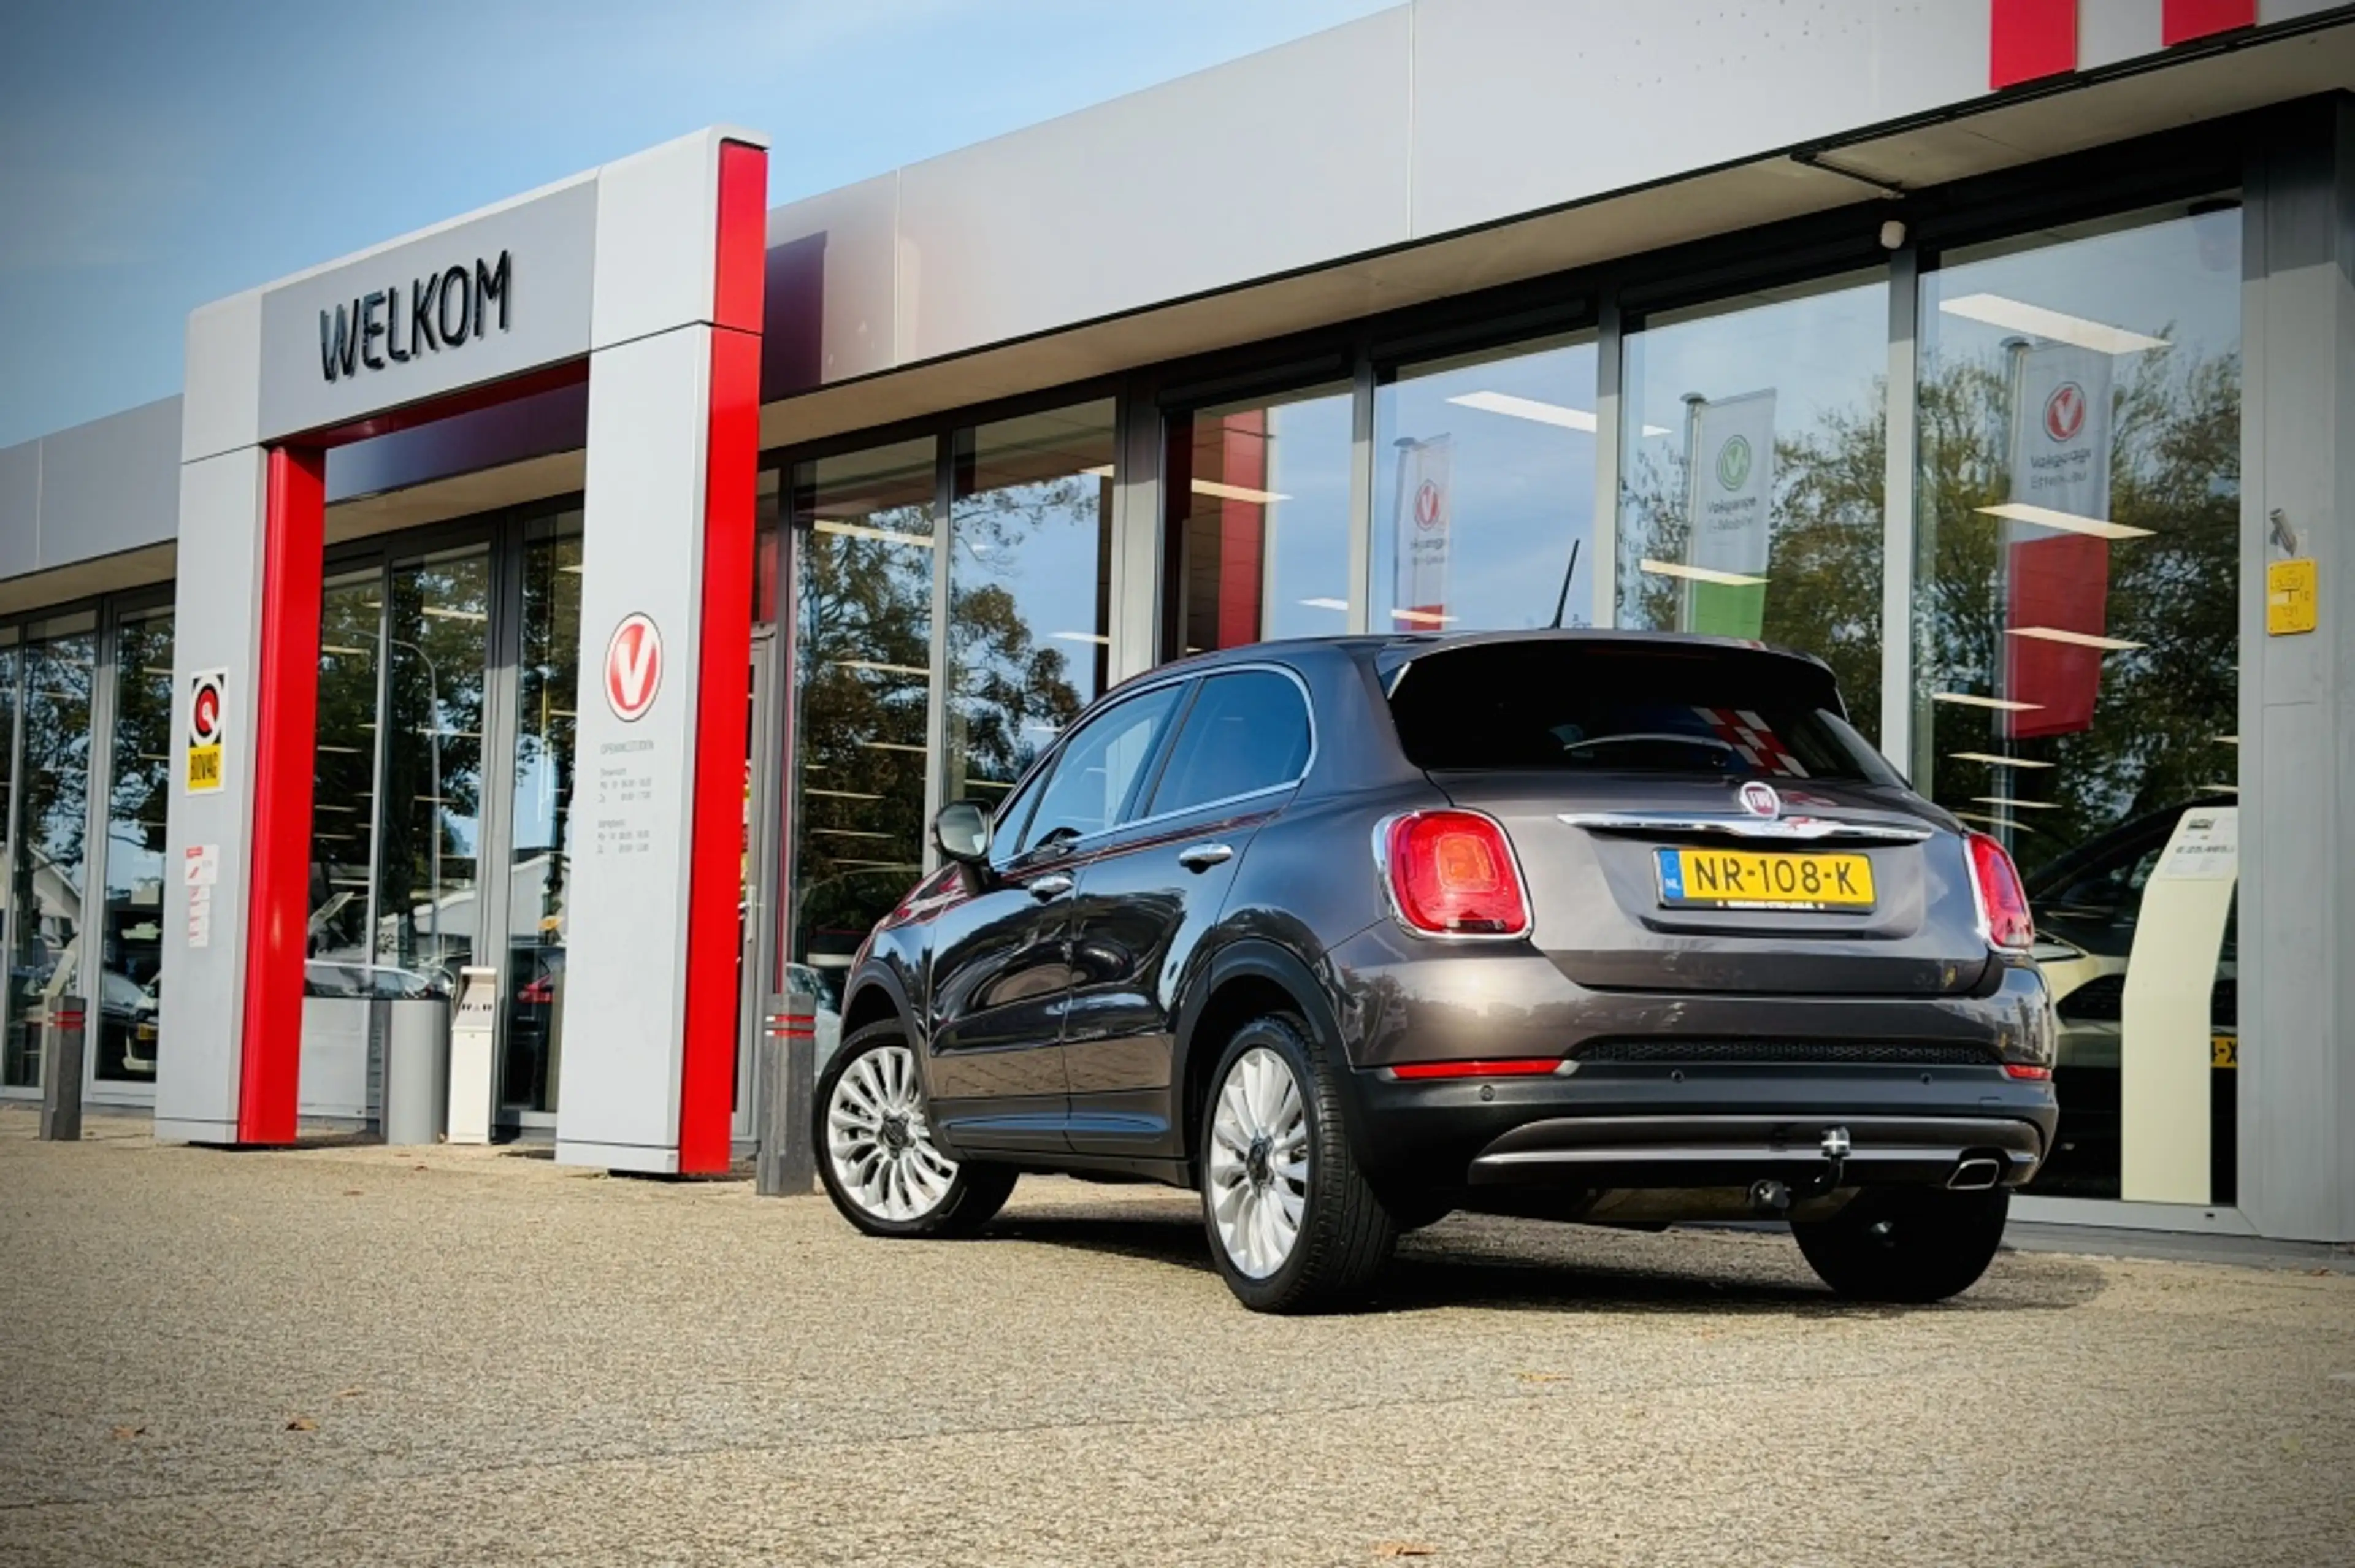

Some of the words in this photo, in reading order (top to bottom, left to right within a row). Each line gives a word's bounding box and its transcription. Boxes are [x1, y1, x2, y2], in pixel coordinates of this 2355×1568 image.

[320, 249, 511, 383] WELKOM
[1664, 878, 1681, 890] NL
[1694, 857, 1858, 895] NR-108-K
